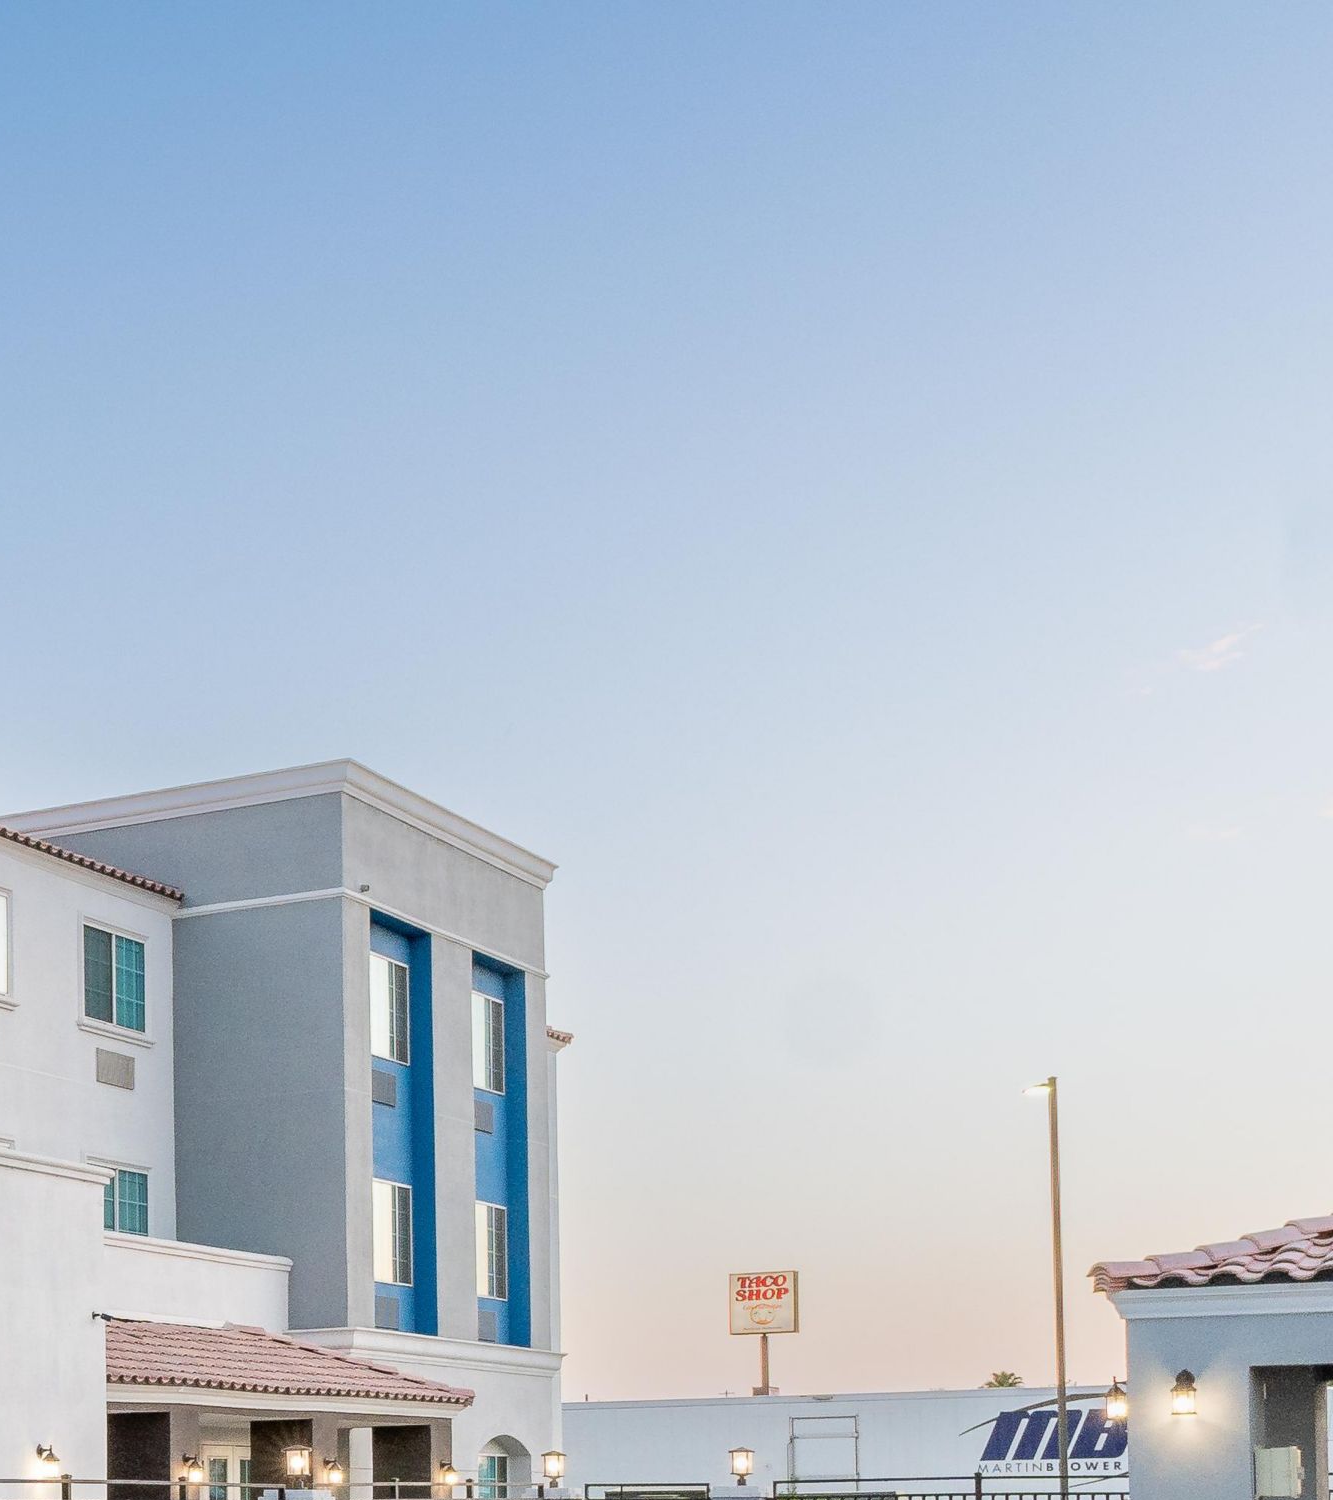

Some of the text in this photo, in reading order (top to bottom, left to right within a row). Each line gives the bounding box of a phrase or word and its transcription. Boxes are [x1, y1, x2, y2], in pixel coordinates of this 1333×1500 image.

[737, 1274, 787, 1289] TACO
[735, 1288, 789, 1302] SHOP
[978, 1462, 1122, 1474] MARTINBOWER
